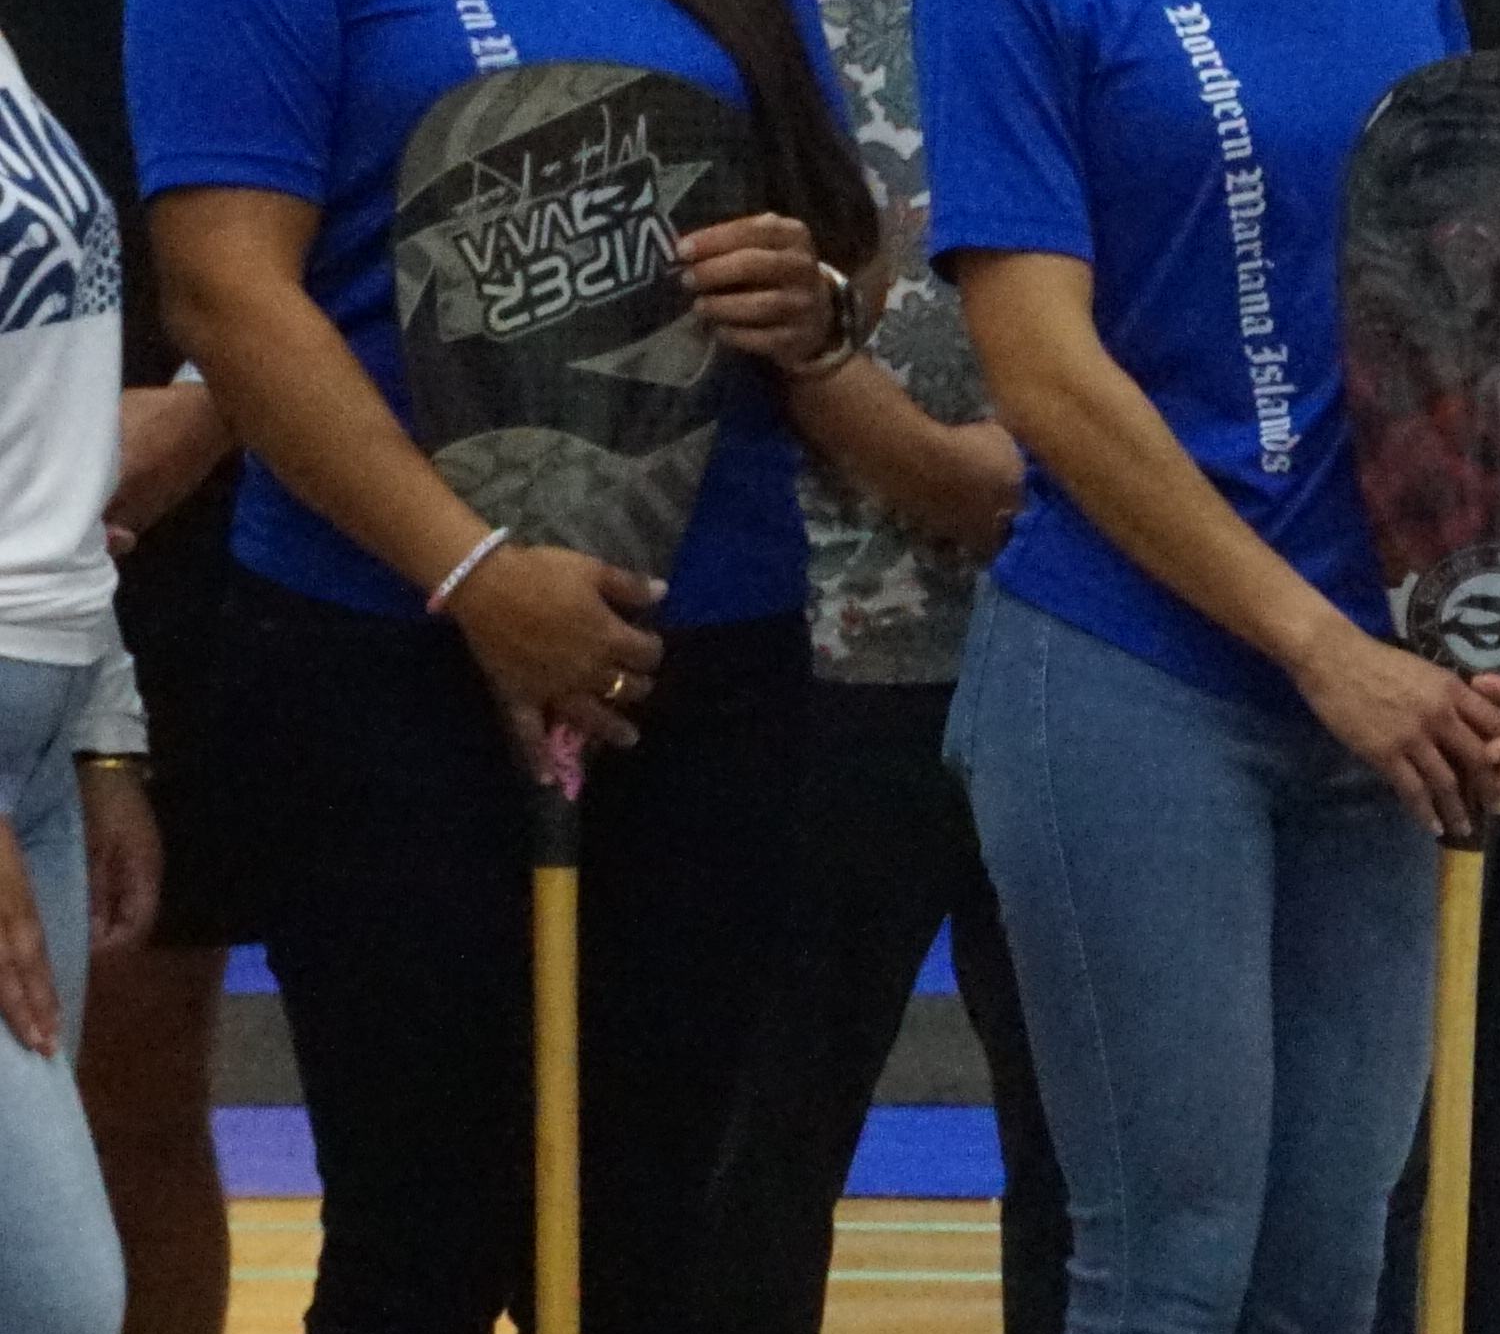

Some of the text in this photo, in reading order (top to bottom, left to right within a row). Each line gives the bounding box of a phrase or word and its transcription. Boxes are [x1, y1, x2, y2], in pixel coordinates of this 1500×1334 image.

[480, 215, 676, 333] VIPER
[1164, 0, 1302, 476] Northern Mariana Islands
